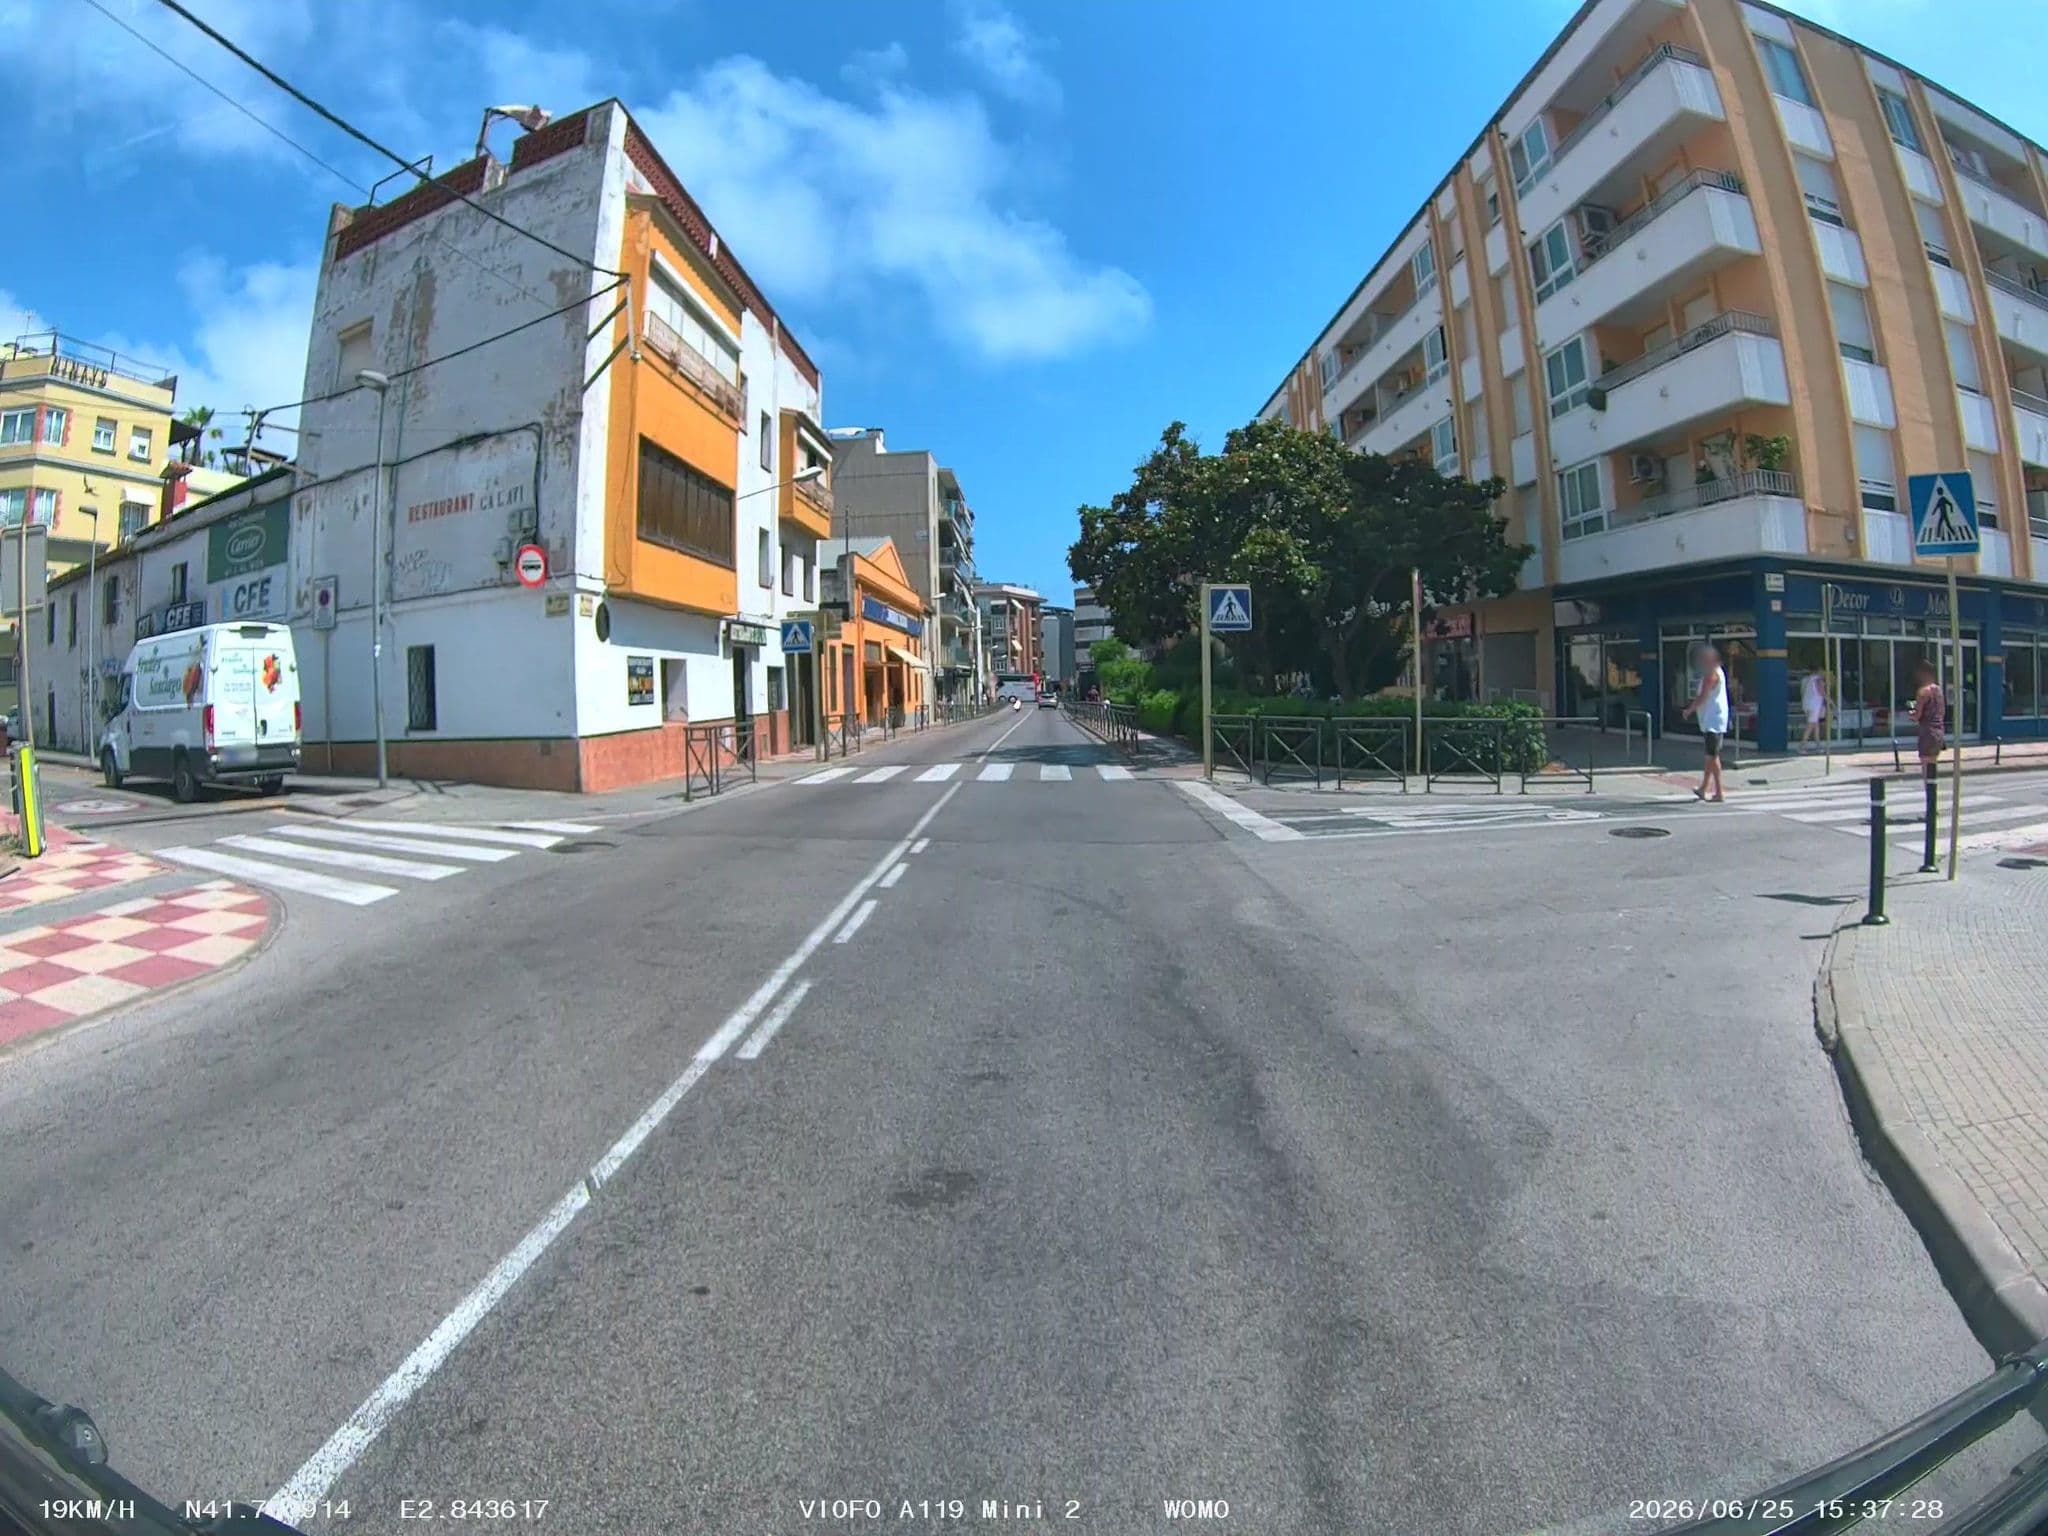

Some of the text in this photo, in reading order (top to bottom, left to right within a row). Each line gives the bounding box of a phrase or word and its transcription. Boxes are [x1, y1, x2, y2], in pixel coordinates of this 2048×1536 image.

[408, 493, 475, 523] RESTAURANT
[234, 575, 272, 613] CFE
[1831, 584, 1870, 610] Decor
[166, 605, 192, 627] CFE
